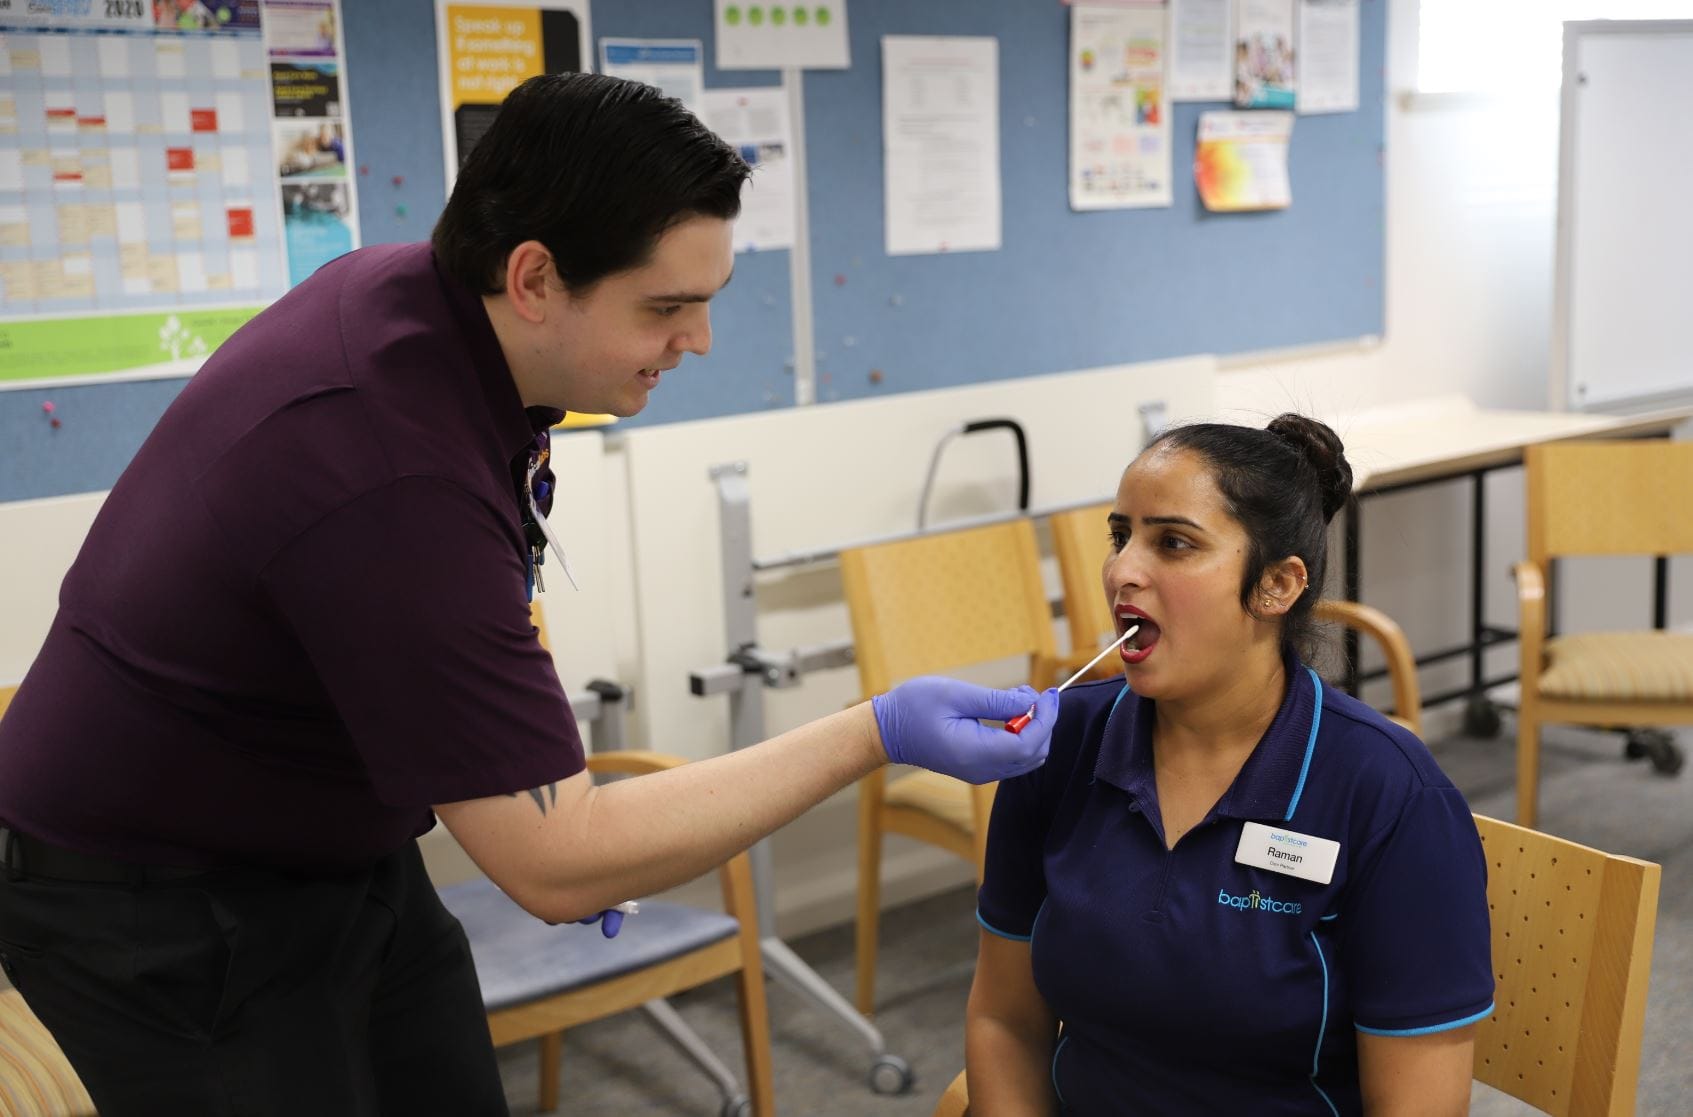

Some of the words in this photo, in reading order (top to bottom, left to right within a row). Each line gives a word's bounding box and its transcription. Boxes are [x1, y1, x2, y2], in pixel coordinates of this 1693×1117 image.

[105, 0, 145, 18] 2020
[455, 15, 501, 34] Speak
[506, 20, 526, 37] up
[1267, 846, 1303, 864] Raman
